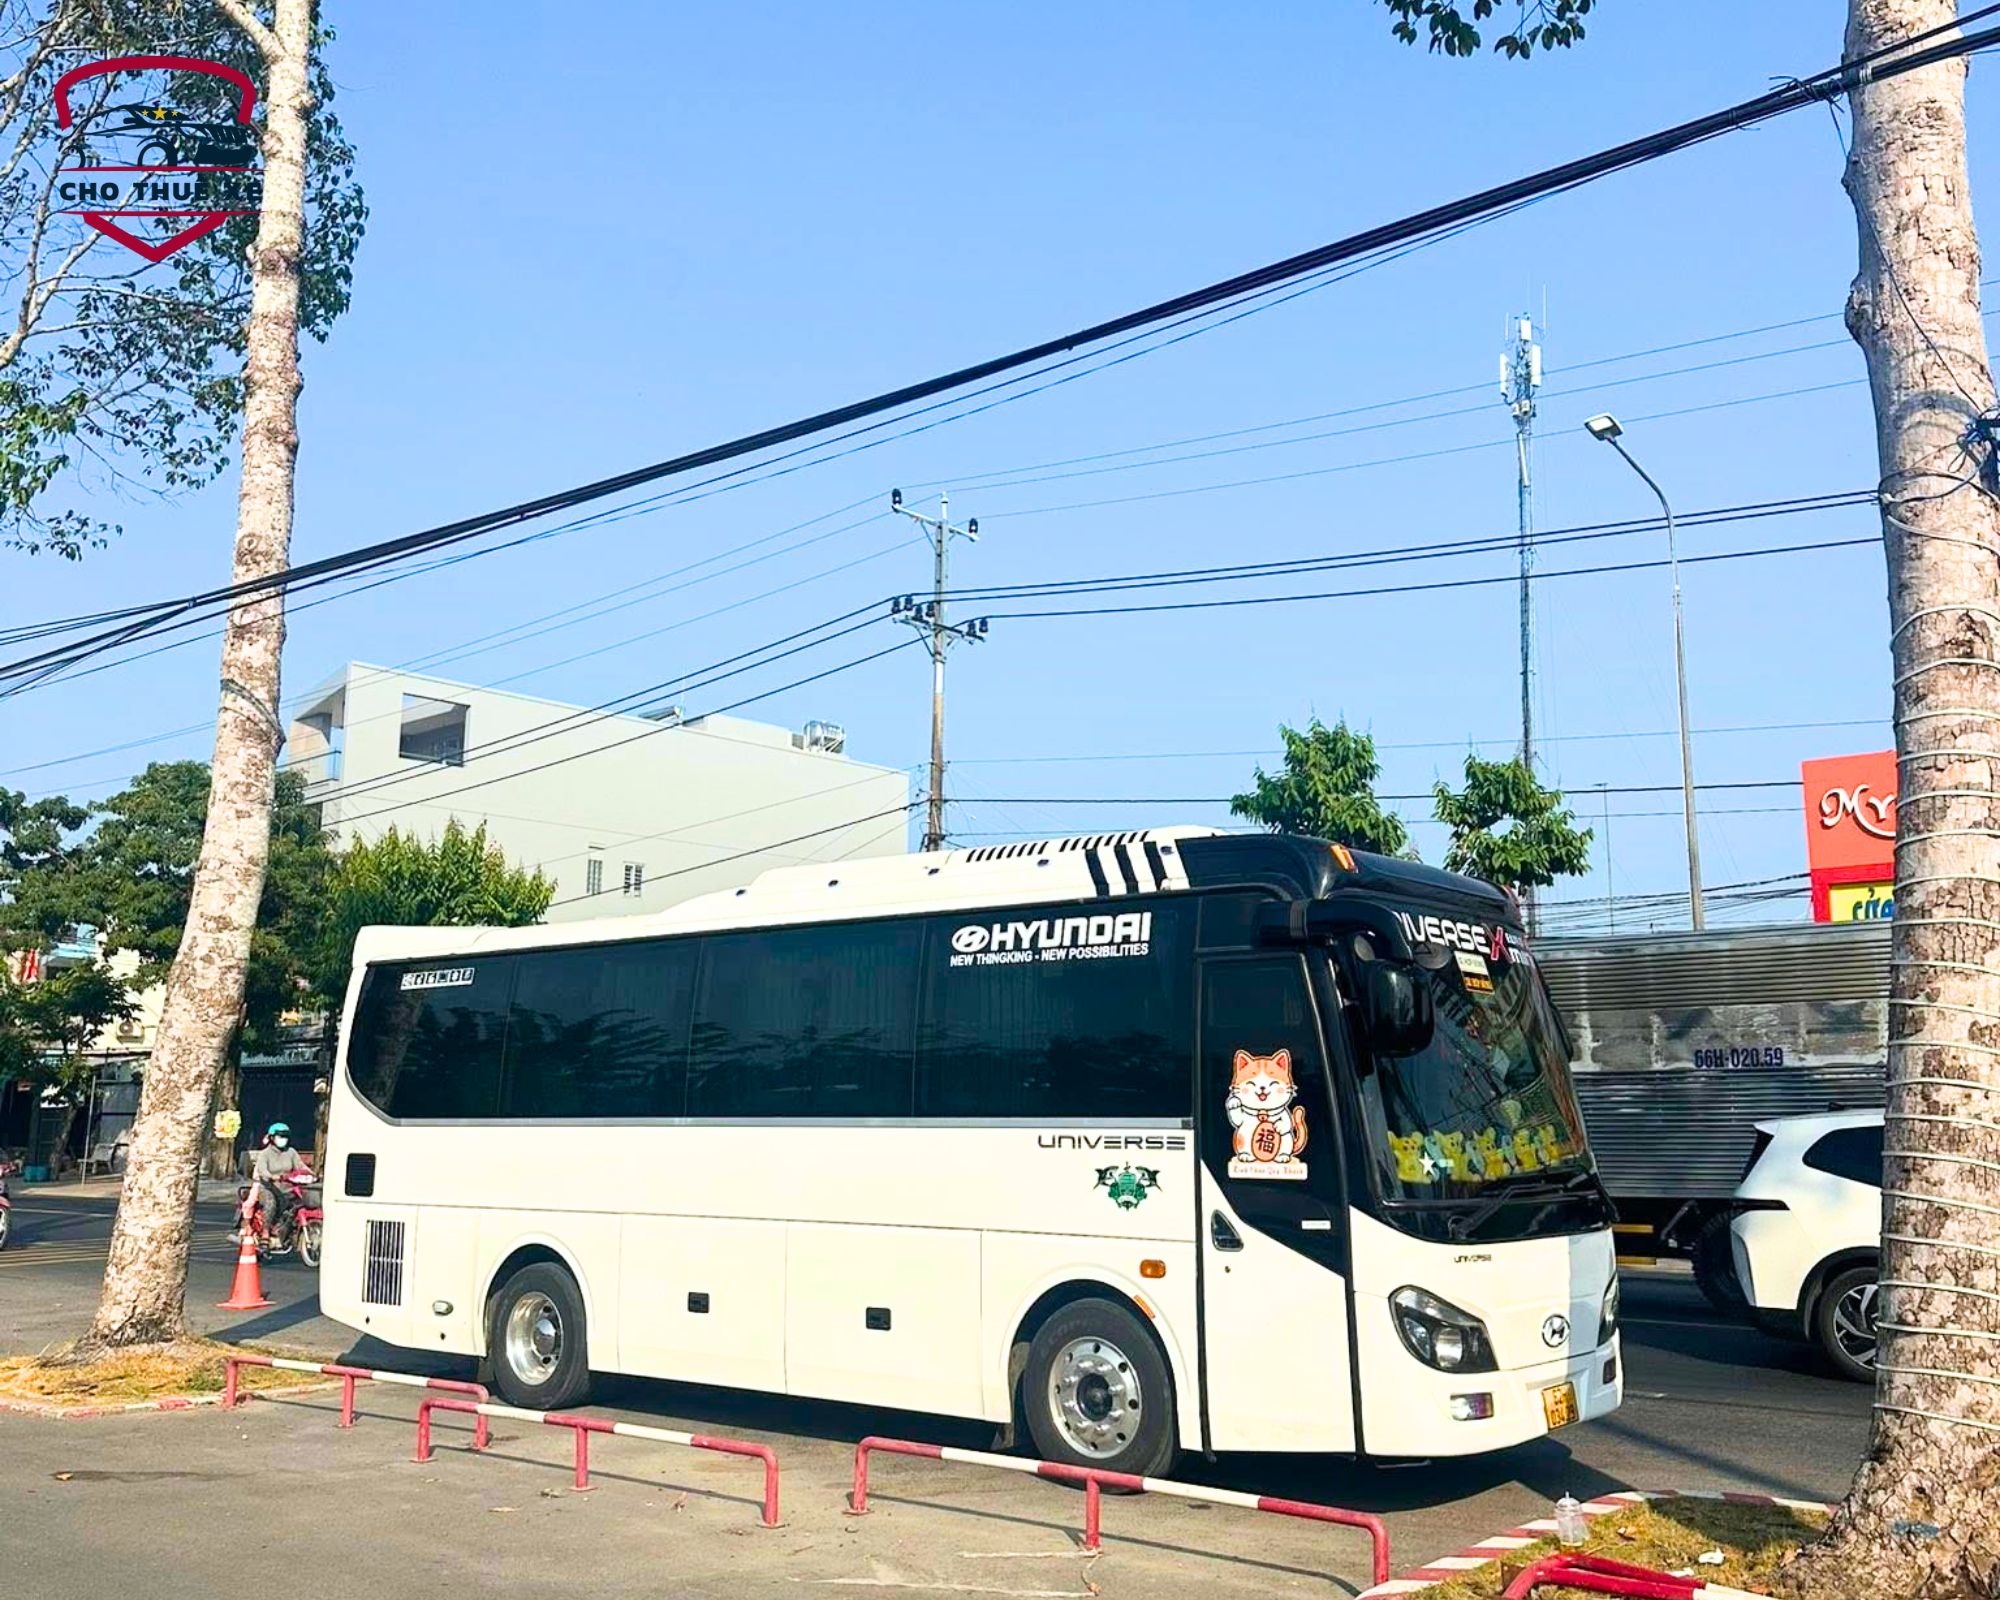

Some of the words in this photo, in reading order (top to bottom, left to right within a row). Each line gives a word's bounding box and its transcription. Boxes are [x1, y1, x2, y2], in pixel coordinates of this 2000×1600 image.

[991, 912, 1152, 951] HYUNDAI
[949, 953, 975, 968] NEW
[975, 950, 1034, 966] THINGKING
[1041, 947, 1067, 962] NEW
[1067, 942, 1150, 961] POSSIBILITIES
[1694, 1046, 1784, 1069] 66H-020.59
[1038, 1135, 1186, 1150] UNIVERSE
